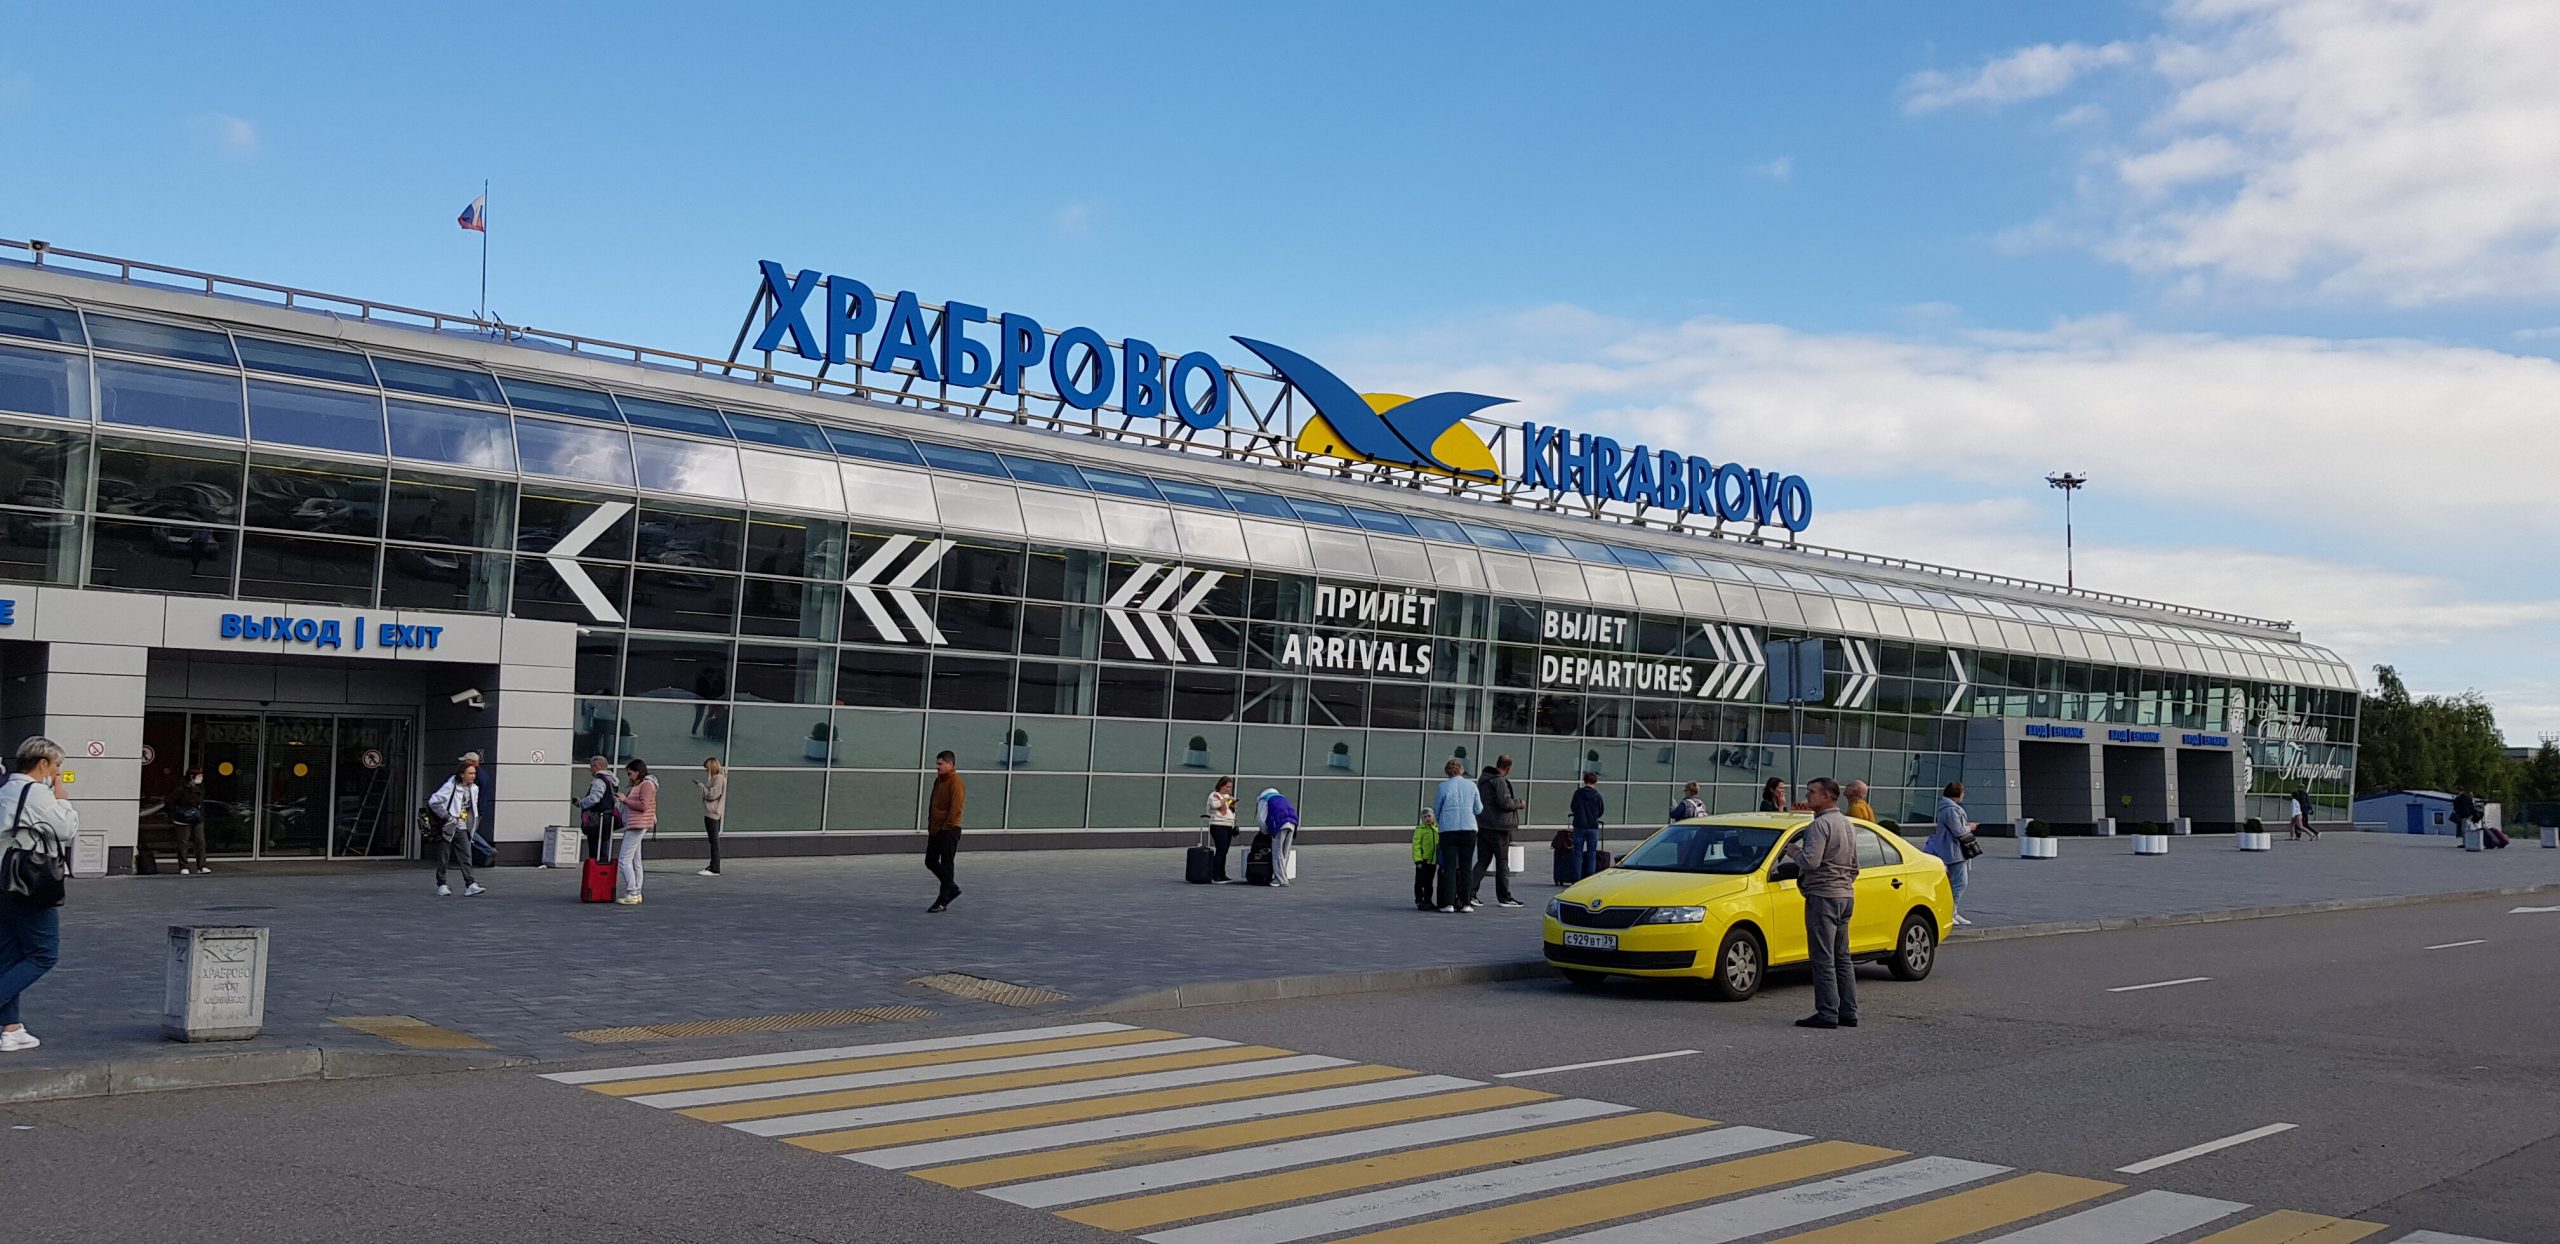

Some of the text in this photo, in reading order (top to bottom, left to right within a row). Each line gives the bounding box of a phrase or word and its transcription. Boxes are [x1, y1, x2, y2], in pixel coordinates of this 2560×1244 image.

[752, 259, 1228, 430] ХРАБРОВО
[1522, 421, 1813, 532] KHRABROVO
[1315, 587, 1436, 626] ПРИЛЁТ
[220, 613, 444, 649] ВЫХОД EXIT
[1543, 610, 1628, 645] ВЫЛЕТ
[1281, 633, 1432, 675] ARRIVALS
[1541, 654, 1693, 693] DEPARTURES
